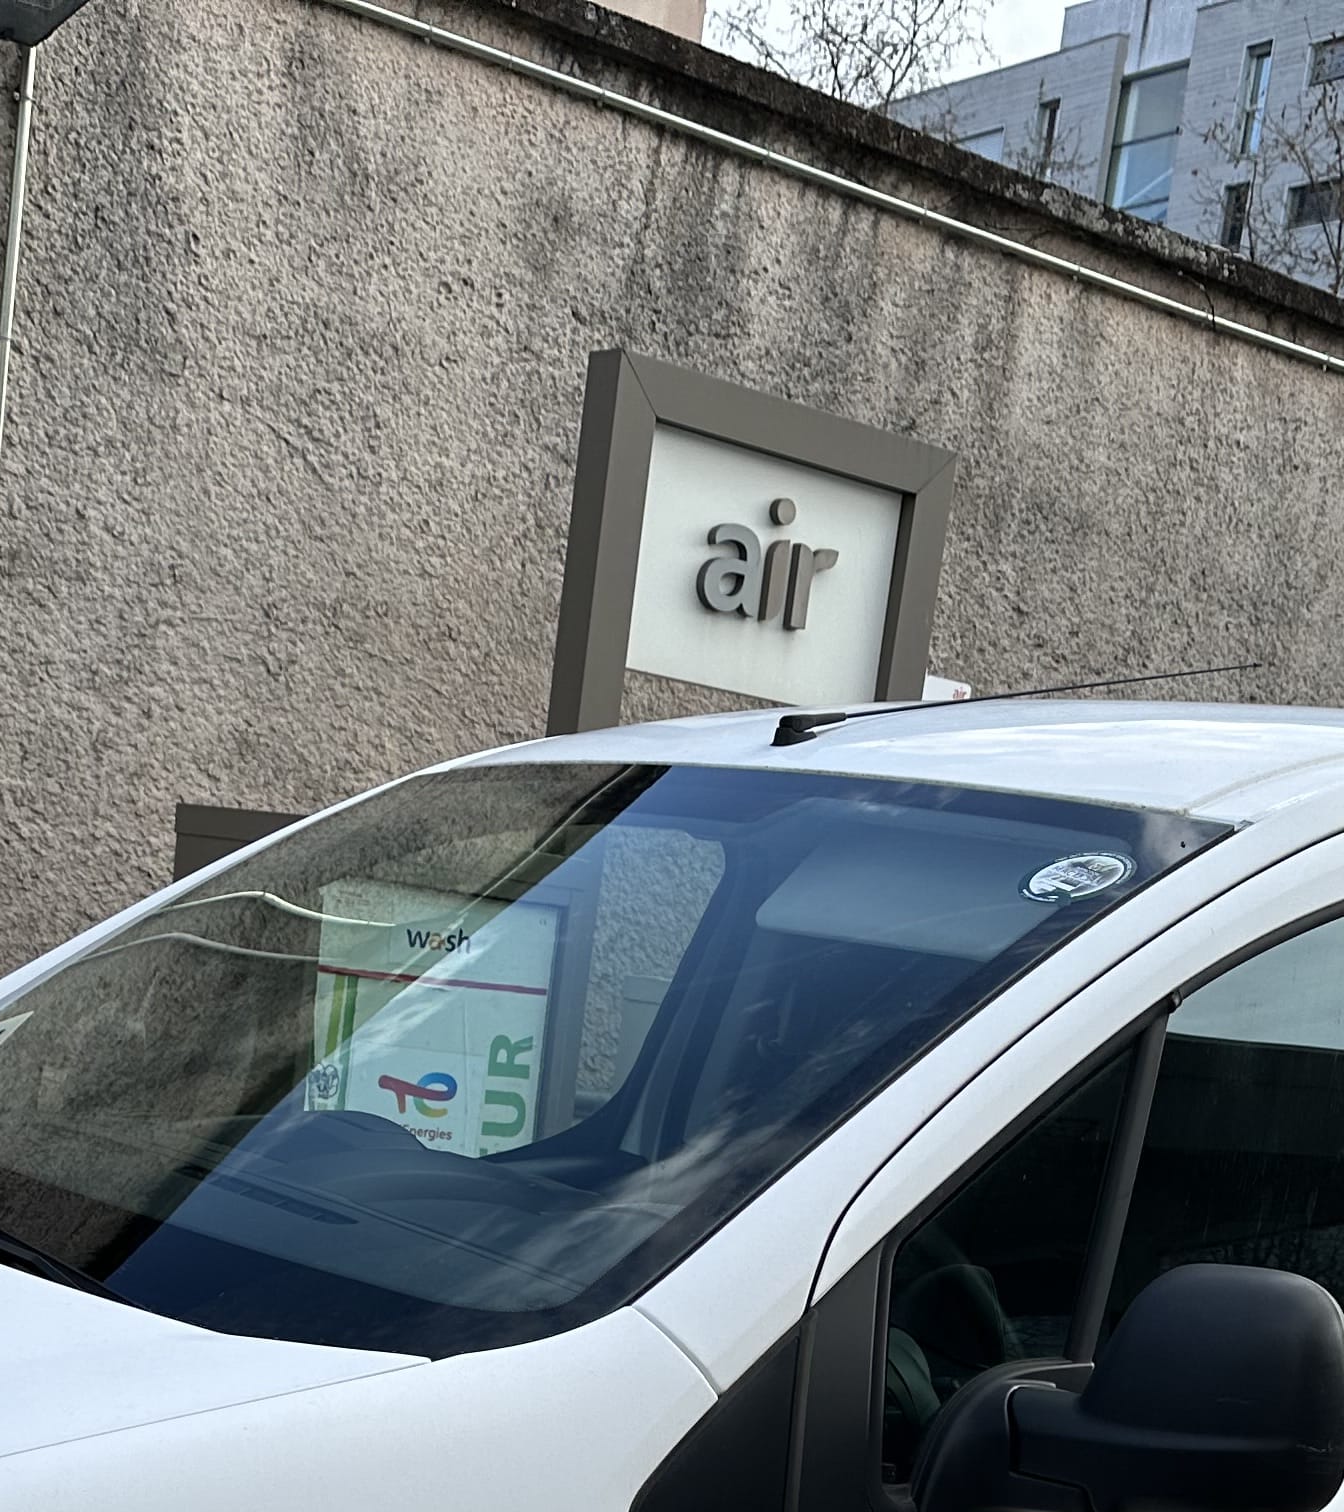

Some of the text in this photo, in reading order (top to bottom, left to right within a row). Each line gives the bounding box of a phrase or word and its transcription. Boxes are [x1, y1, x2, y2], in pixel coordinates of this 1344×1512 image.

[696, 497, 839, 631] air
[406, 928, 472, 954] wash
[478, 1034, 534, 1155] UR
[403, 1124, 453, 1141] nergies
